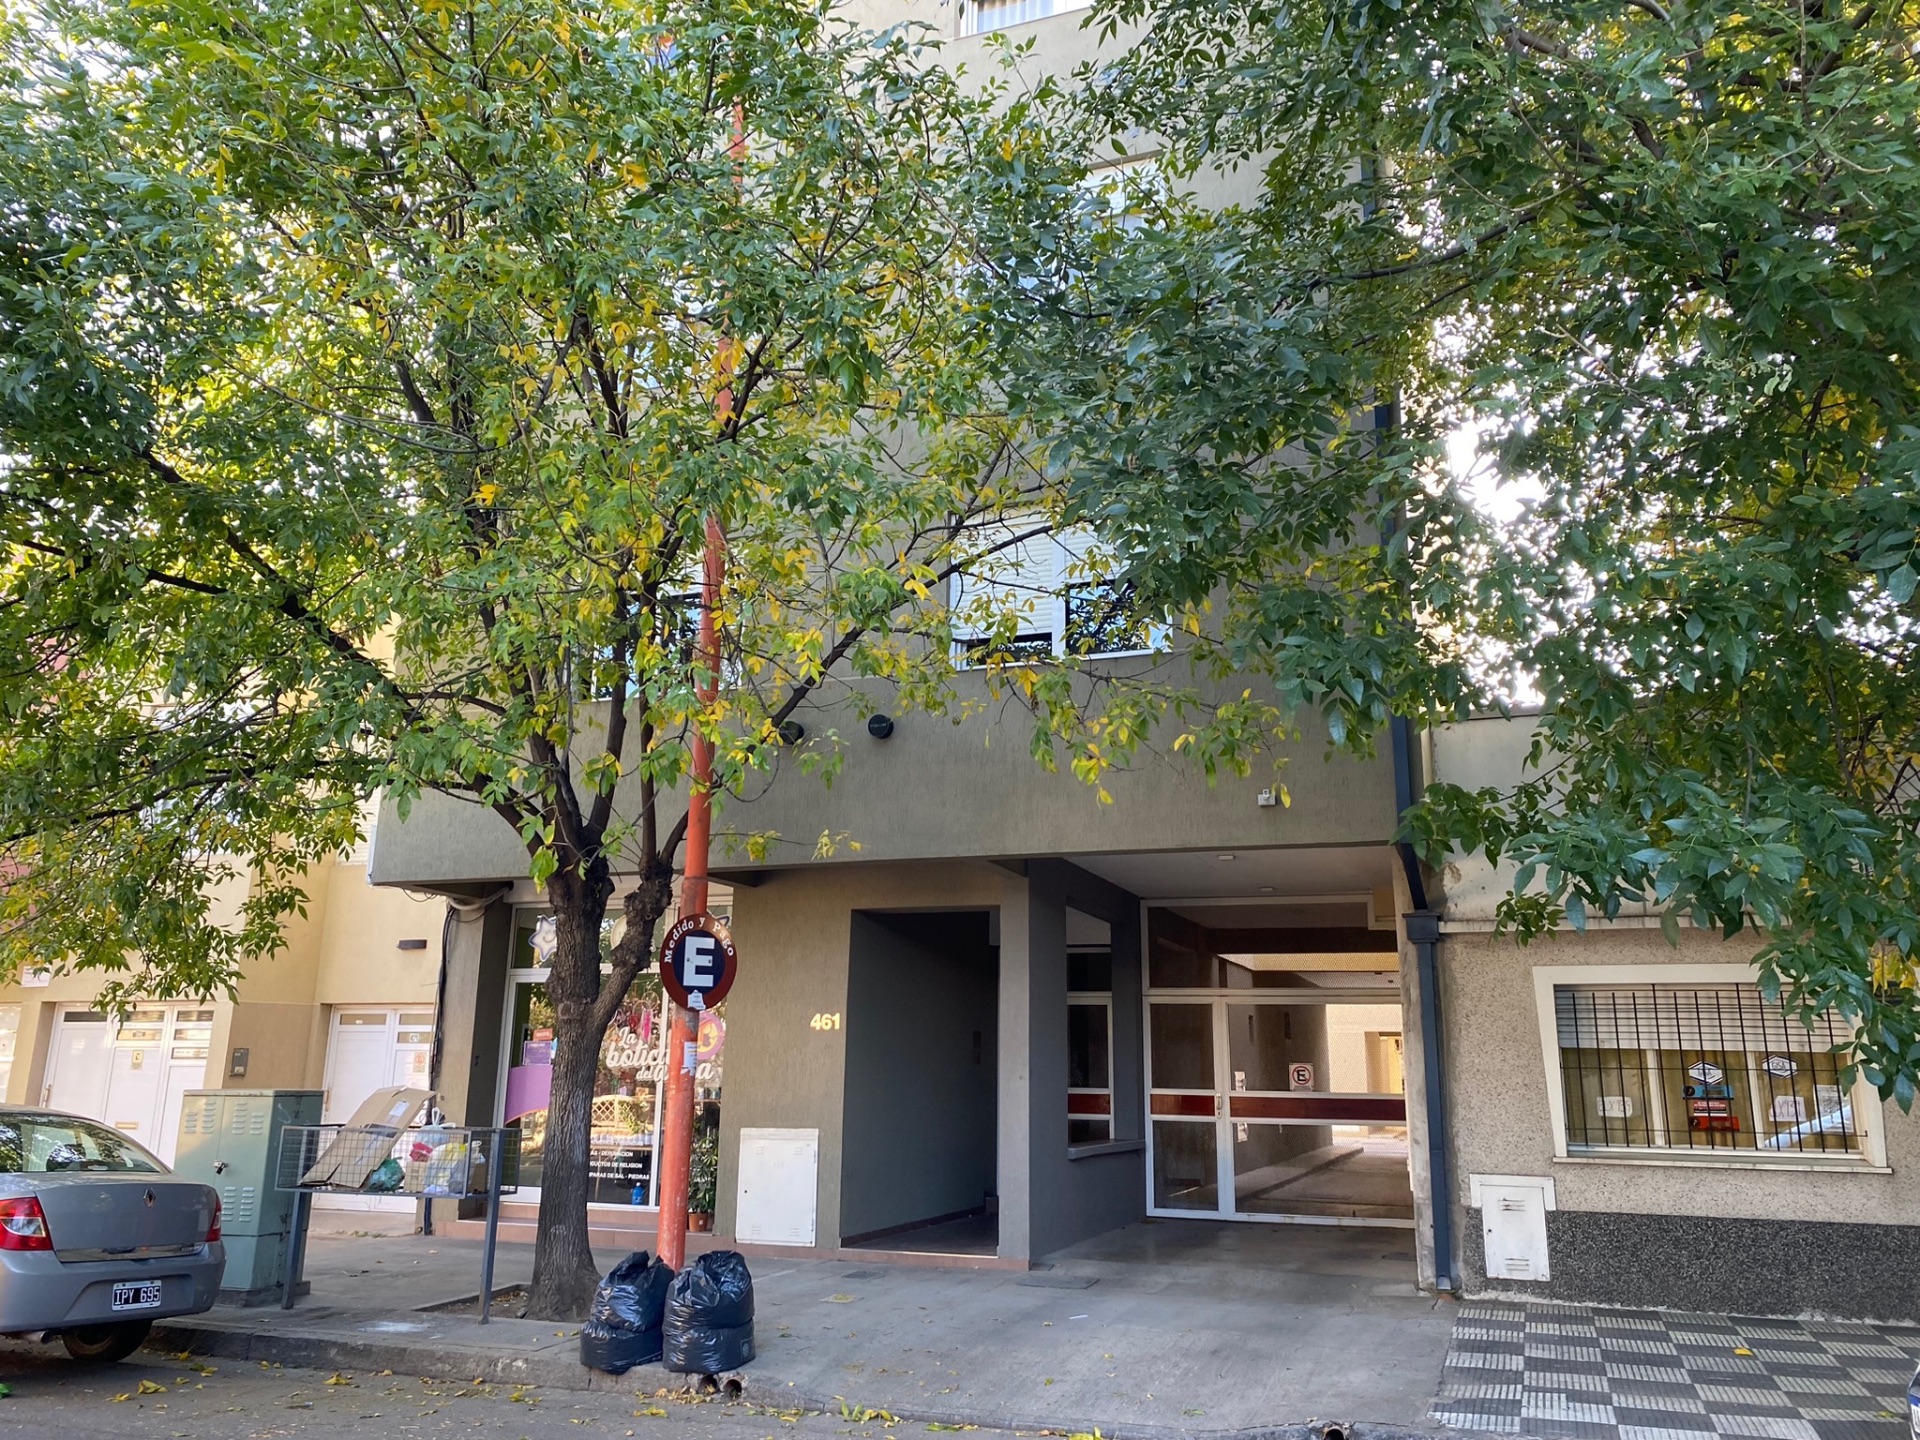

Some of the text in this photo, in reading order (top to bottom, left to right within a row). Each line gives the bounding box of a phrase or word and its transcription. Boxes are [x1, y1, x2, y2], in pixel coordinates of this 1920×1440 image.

[664, 917, 734, 963] Medido y Pago
[683, 936, 715, 987] E
[810, 1013, 840, 1030] 461
[618, 1026, 637, 1049] La
[1297, 1069, 1306, 1081] E
[114, 1286, 160, 1305] IPY 695
